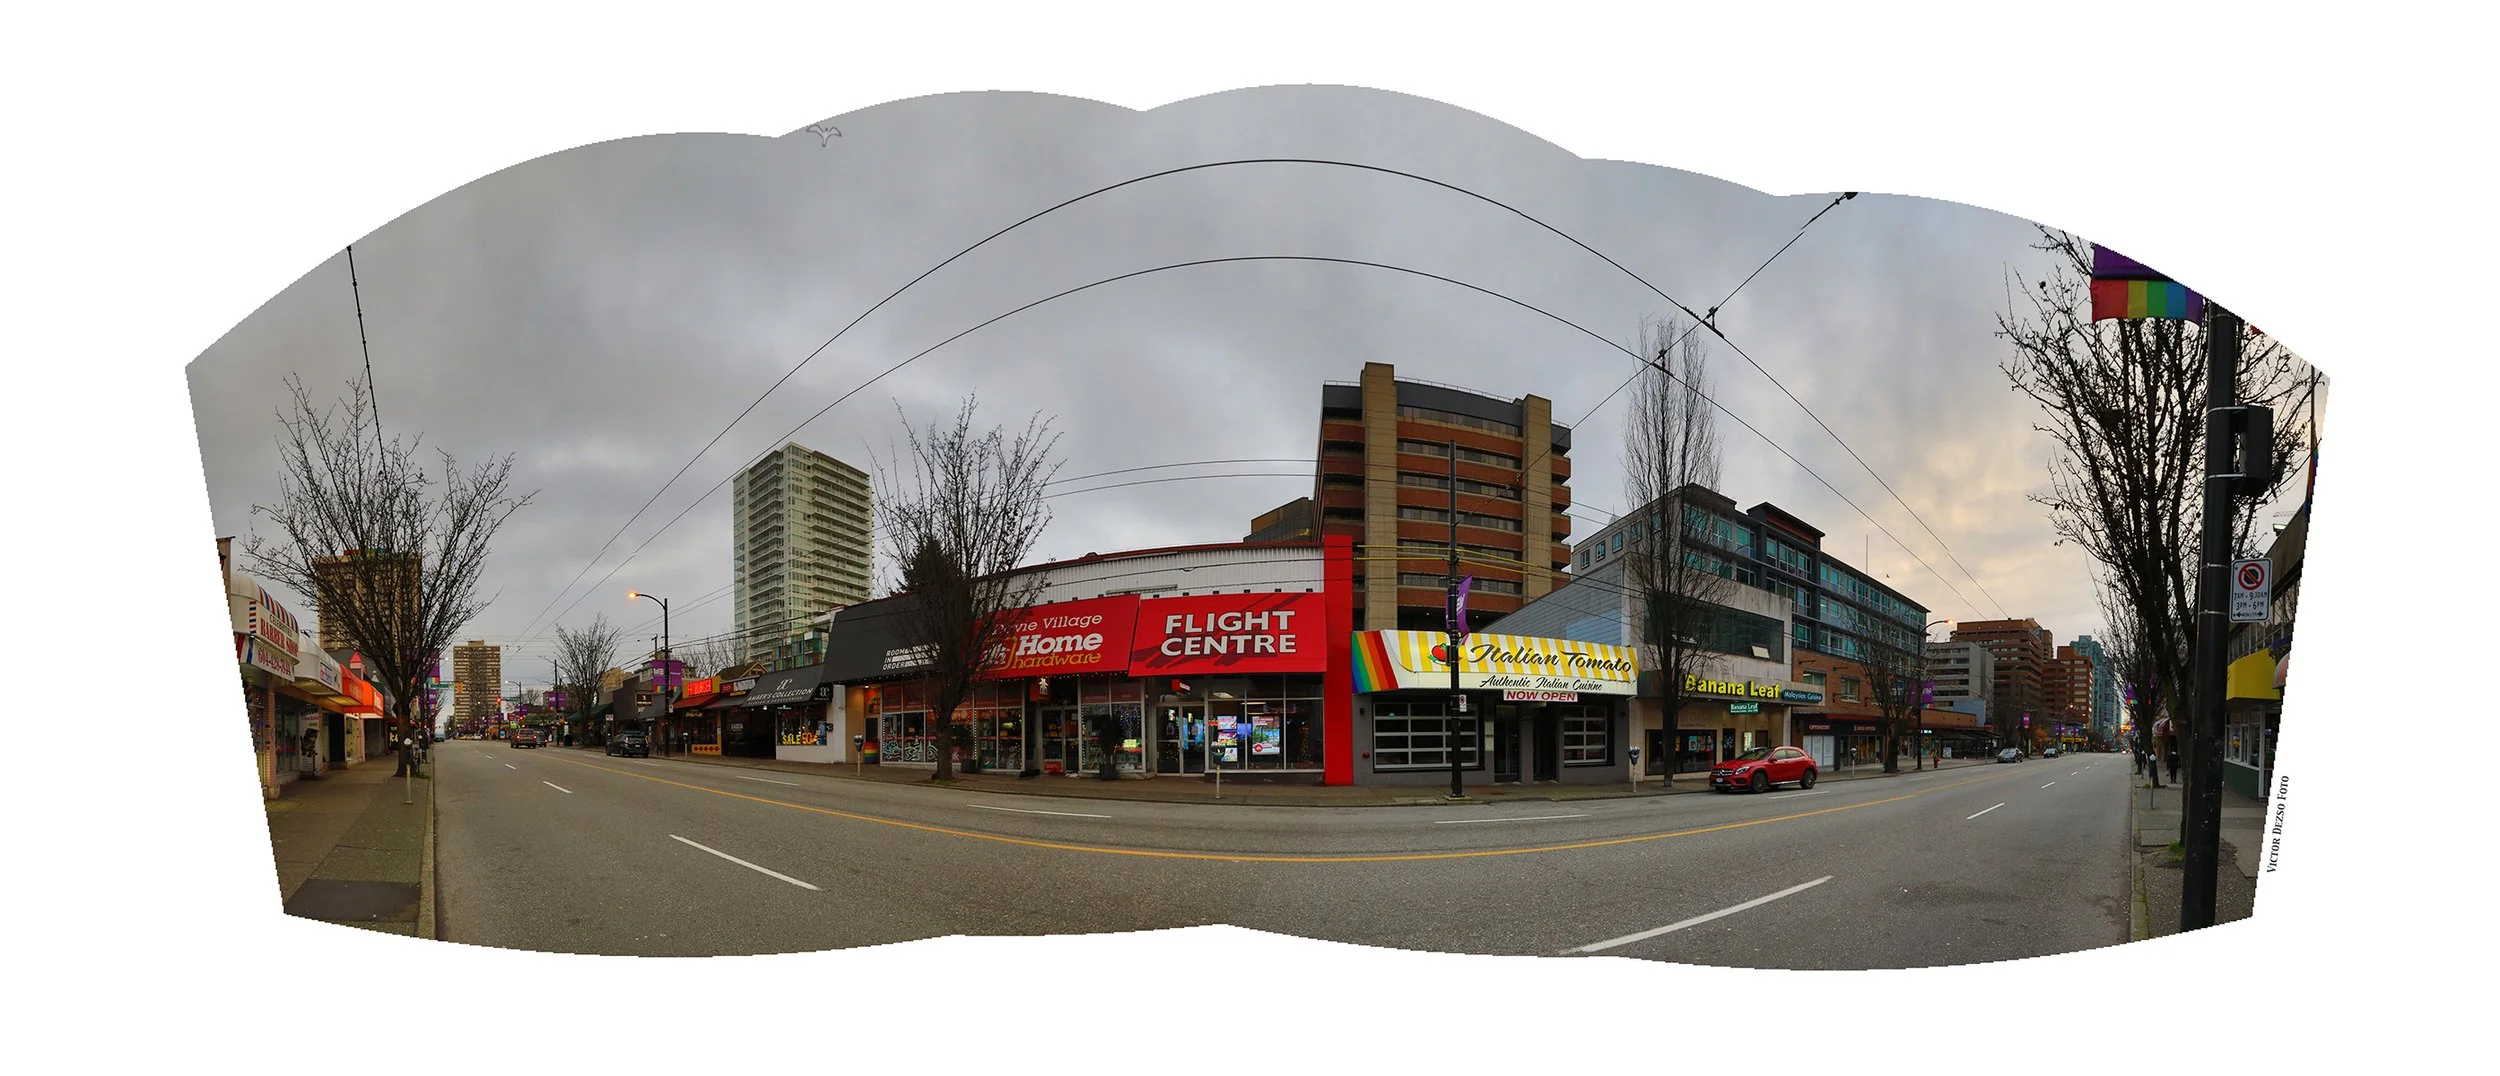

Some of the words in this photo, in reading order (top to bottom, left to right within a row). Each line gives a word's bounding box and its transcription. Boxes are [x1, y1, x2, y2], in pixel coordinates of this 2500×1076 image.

[2236, 602, 2247, 610] 3PM
[2252, 601, 2264, 610] 6PM
[1043, 614, 1103, 629] Village
[1164, 610, 1296, 634] FLIGHT
[260, 618, 285, 650] BARBER
[1015, 632, 1104, 656] Home
[1160, 634, 1297, 656] CENTRE
[1011, 652, 1101, 669] hardware
[1469, 643, 1560, 666] Italian
[1561, 650, 1632, 673] Tomato
[1479, 675, 1531, 688] Authentic
[1535, 677, 1569, 689] Italian
[1572, 679, 1603, 691] Cuisine
[1685, 673, 1745, 696] Banana
[1750, 680, 1781, 698] Leaf
[772, 688, 814, 698] COLLECTION
[1505, 691, 1539, 700] NOW
[1541, 691, 1576, 701] OPEN
[1748, 702, 1759, 710] Leaf
[782, 733, 801, 745] SALE
